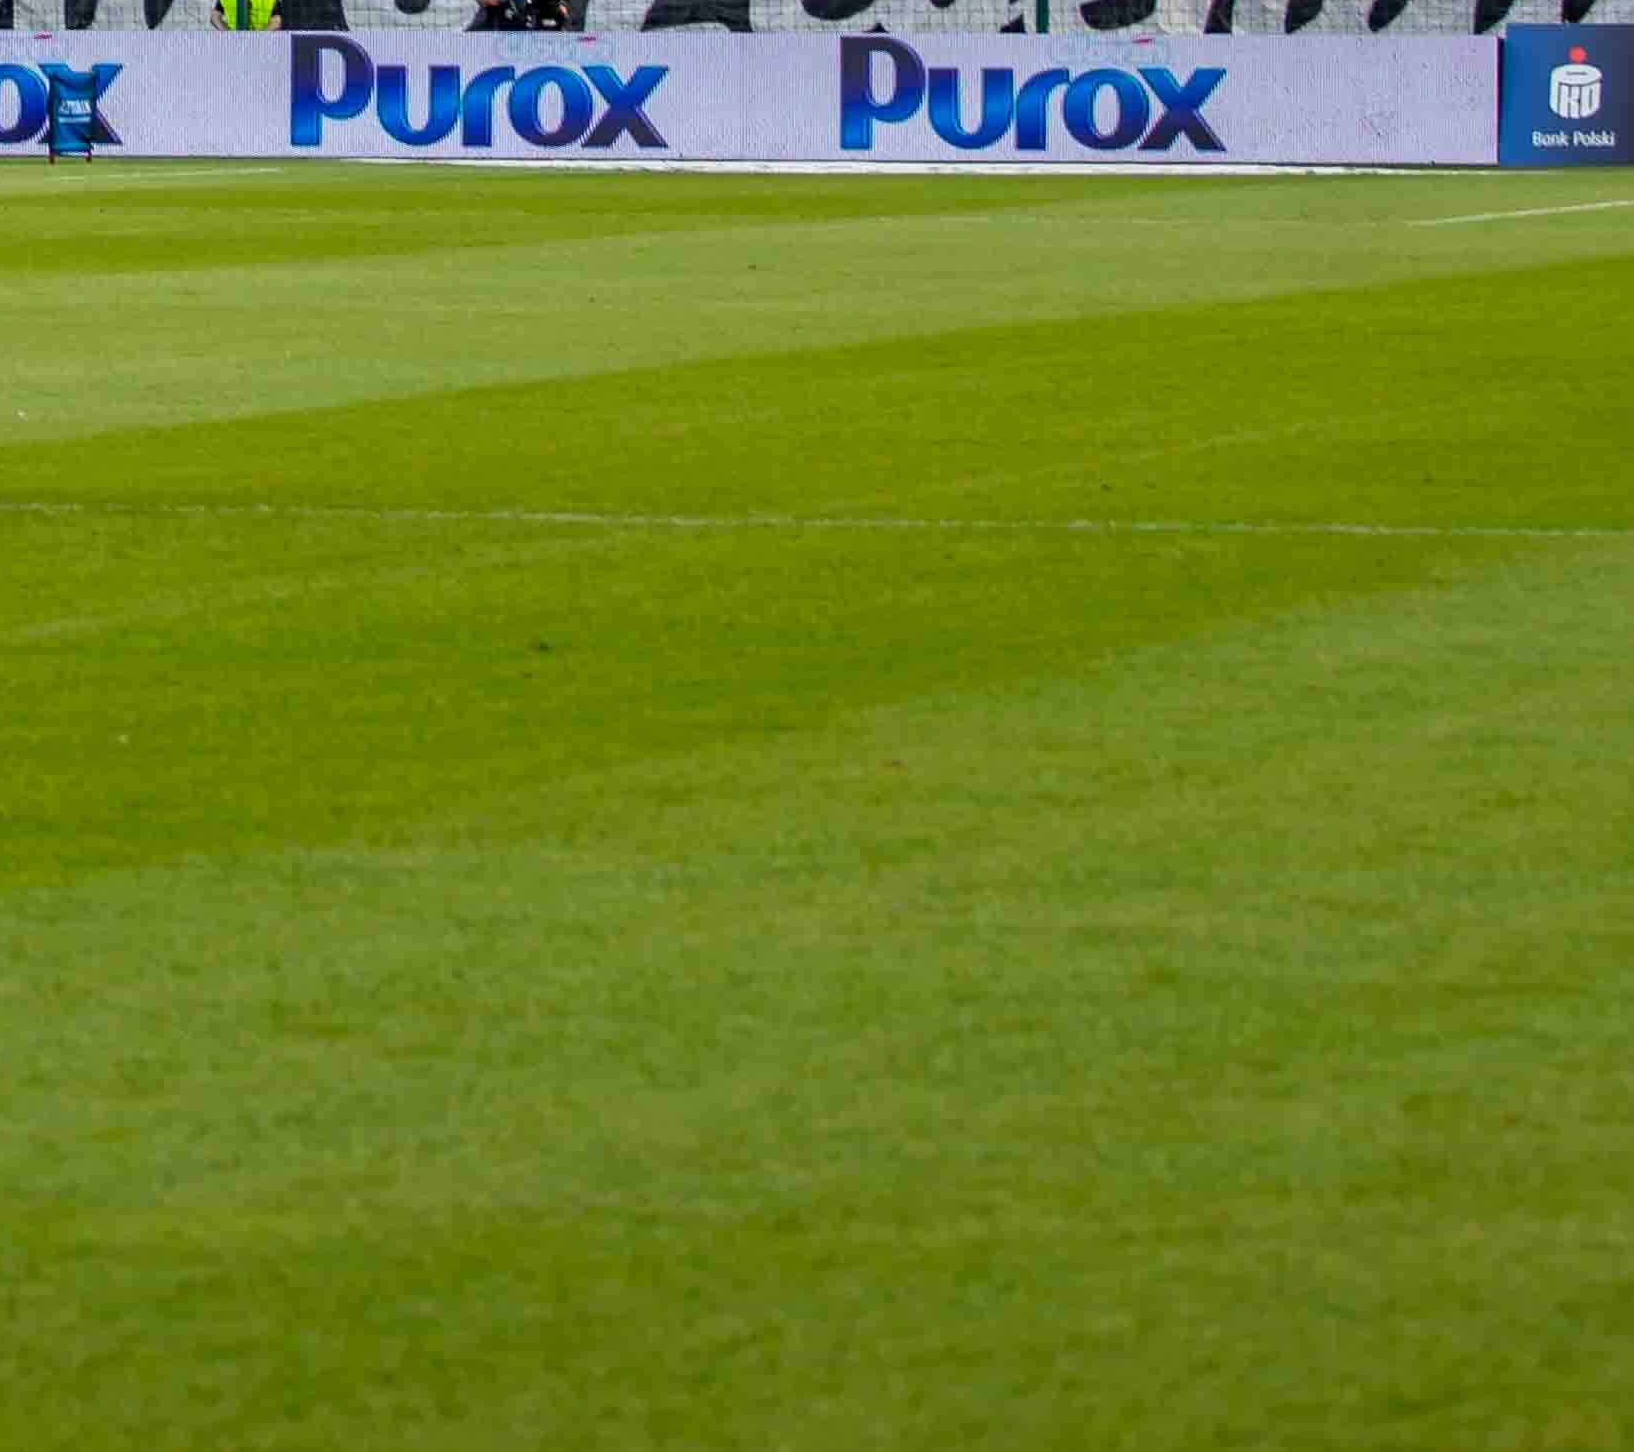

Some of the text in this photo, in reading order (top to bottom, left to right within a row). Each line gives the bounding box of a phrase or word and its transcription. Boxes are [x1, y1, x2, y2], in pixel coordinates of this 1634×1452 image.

[290, 33, 669, 149] Purox
[839, 36, 1227, 153] Purox
[1531, 130, 1616, 147] Bank Polski
